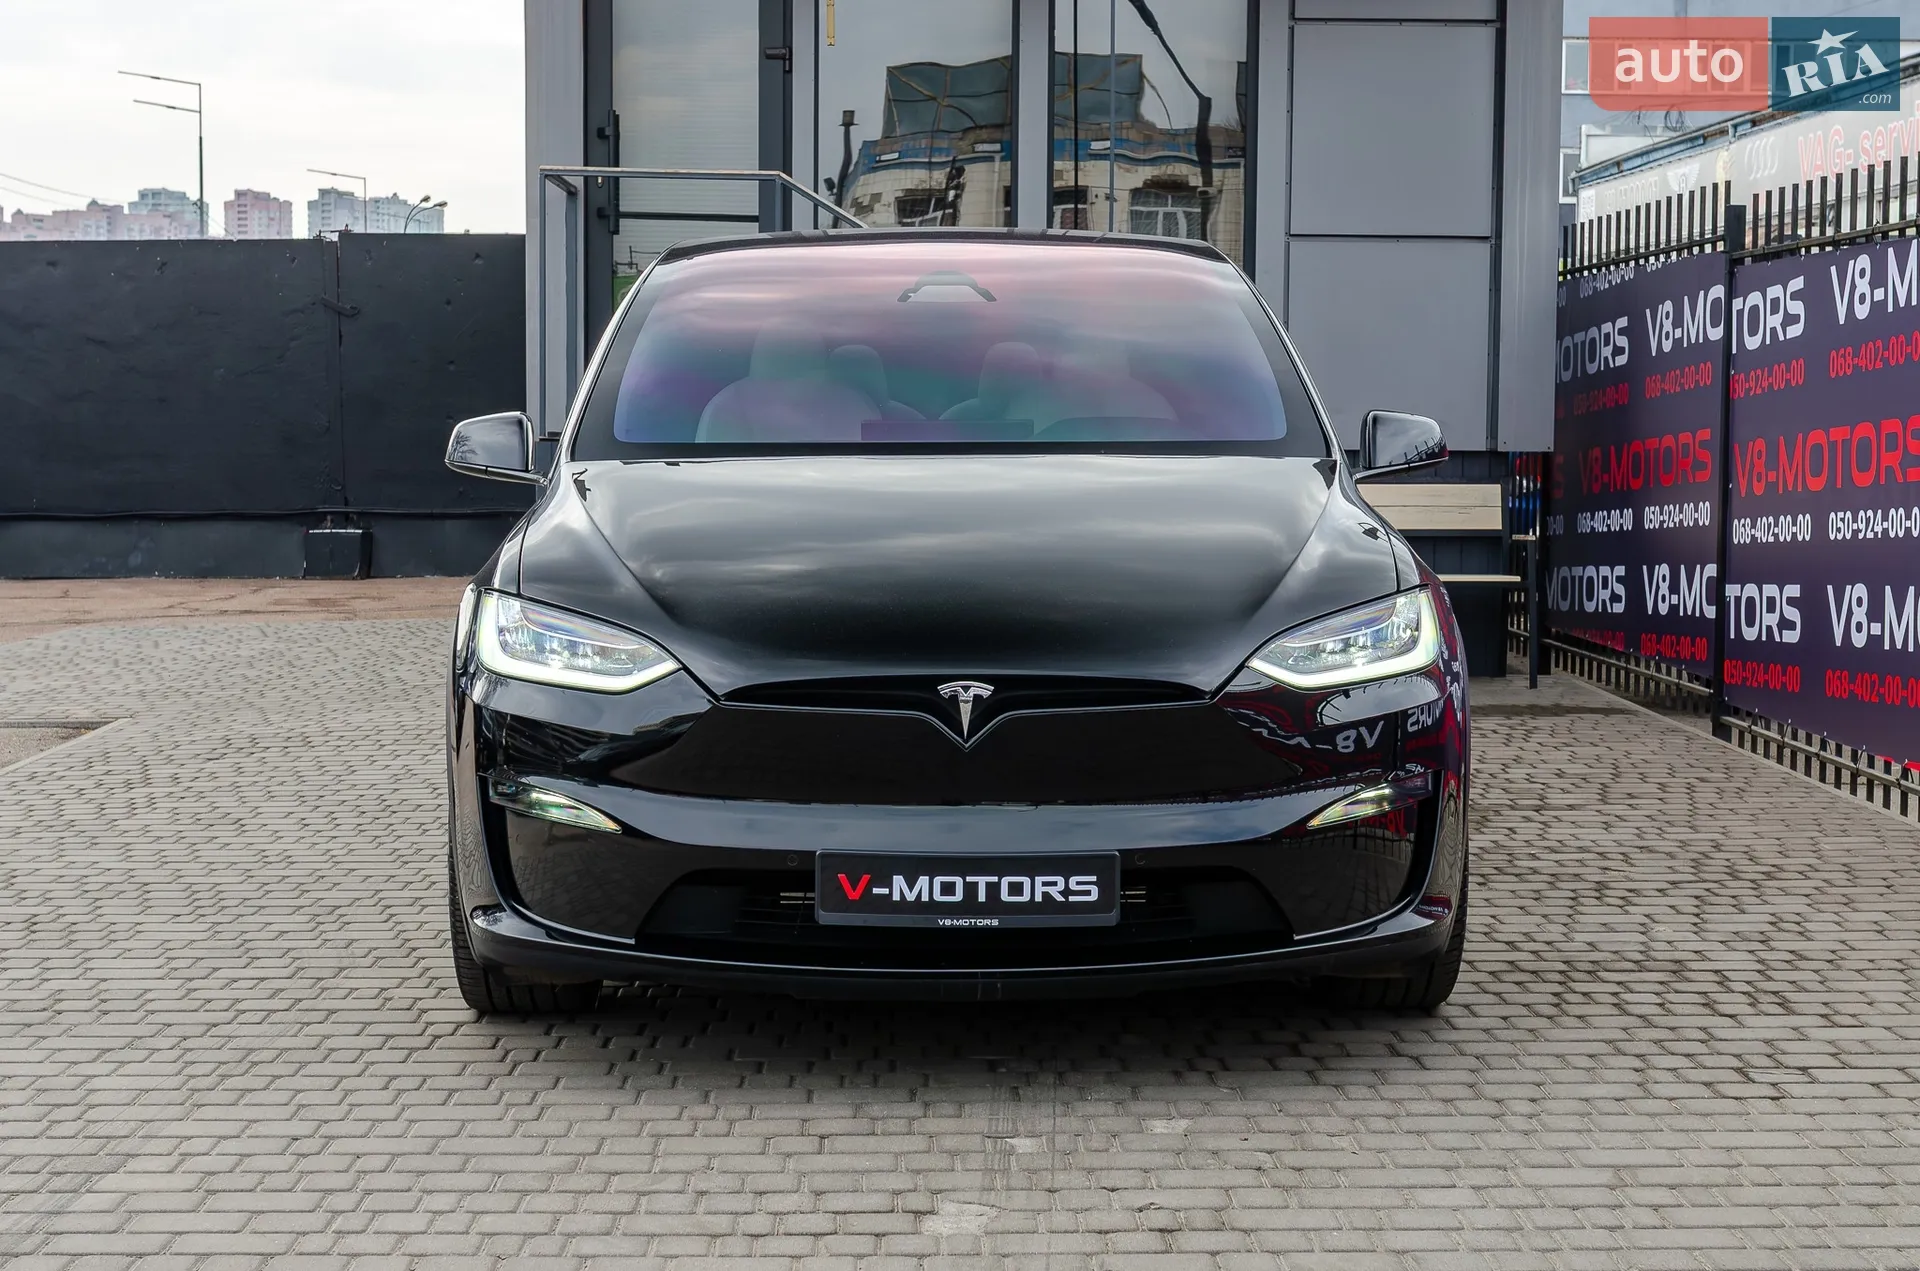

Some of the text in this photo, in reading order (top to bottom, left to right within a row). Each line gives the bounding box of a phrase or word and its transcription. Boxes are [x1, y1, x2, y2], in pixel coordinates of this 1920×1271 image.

[1645, 361, 1713, 400] 068-402-00-00
[1578, 428, 1712, 496] V8-MOTORS
[1577, 508, 1633, 534] 068-402-00-00
[1644, 501, 1711, 530] 050-924-00-00
[1732, 513, 1812, 545] 068-402-00-00
[1725, 583, 1802, 644] TORS
[1641, 632, 1708, 662] 068-402-00-00
[1724, 659, 1801, 693] 050-924-00-00
[837, 873, 1100, 902] V-MOTORS
[937, 918, 1000, 927] V8-MOTORS
